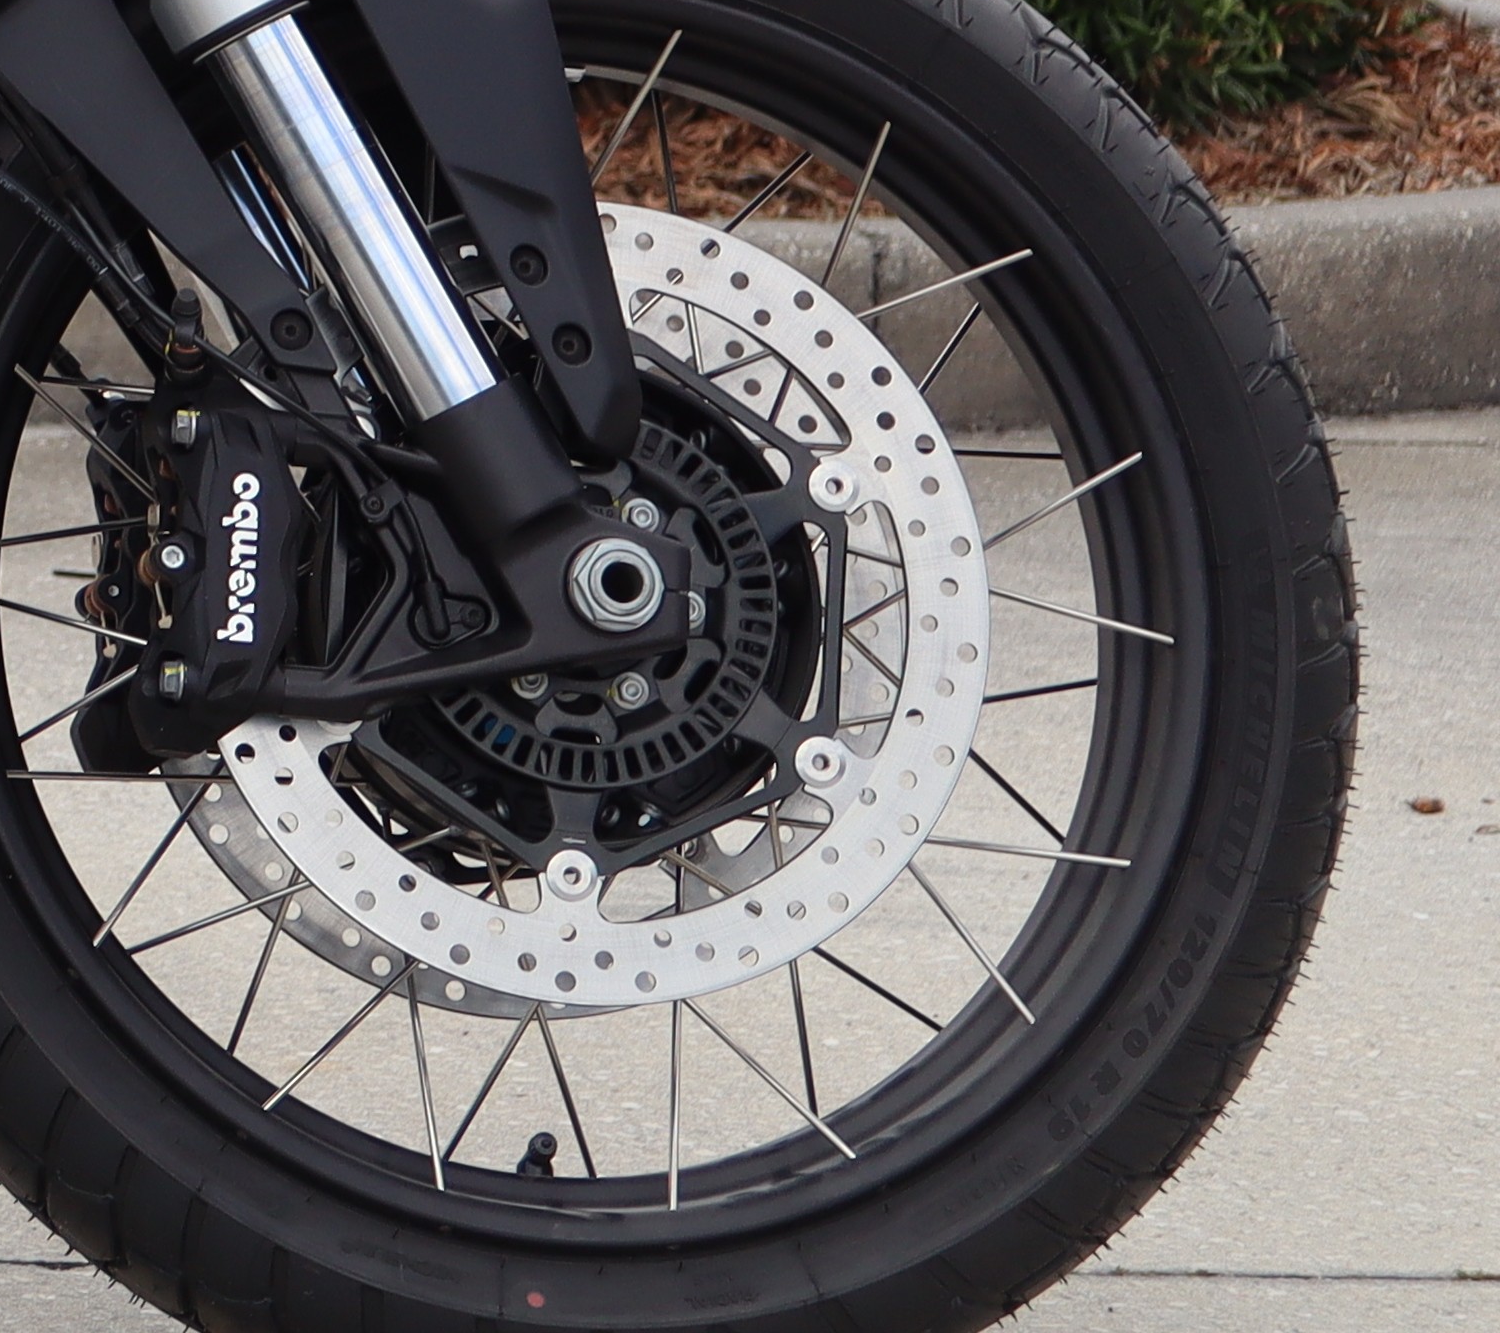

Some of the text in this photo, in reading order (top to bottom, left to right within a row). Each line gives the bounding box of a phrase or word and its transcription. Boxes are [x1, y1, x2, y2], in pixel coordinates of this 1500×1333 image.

[216, 472, 260, 643] brembo
[1207, 607, 1279, 882] MICHELIN
[1115, 908, 1222, 1063] 120/70
